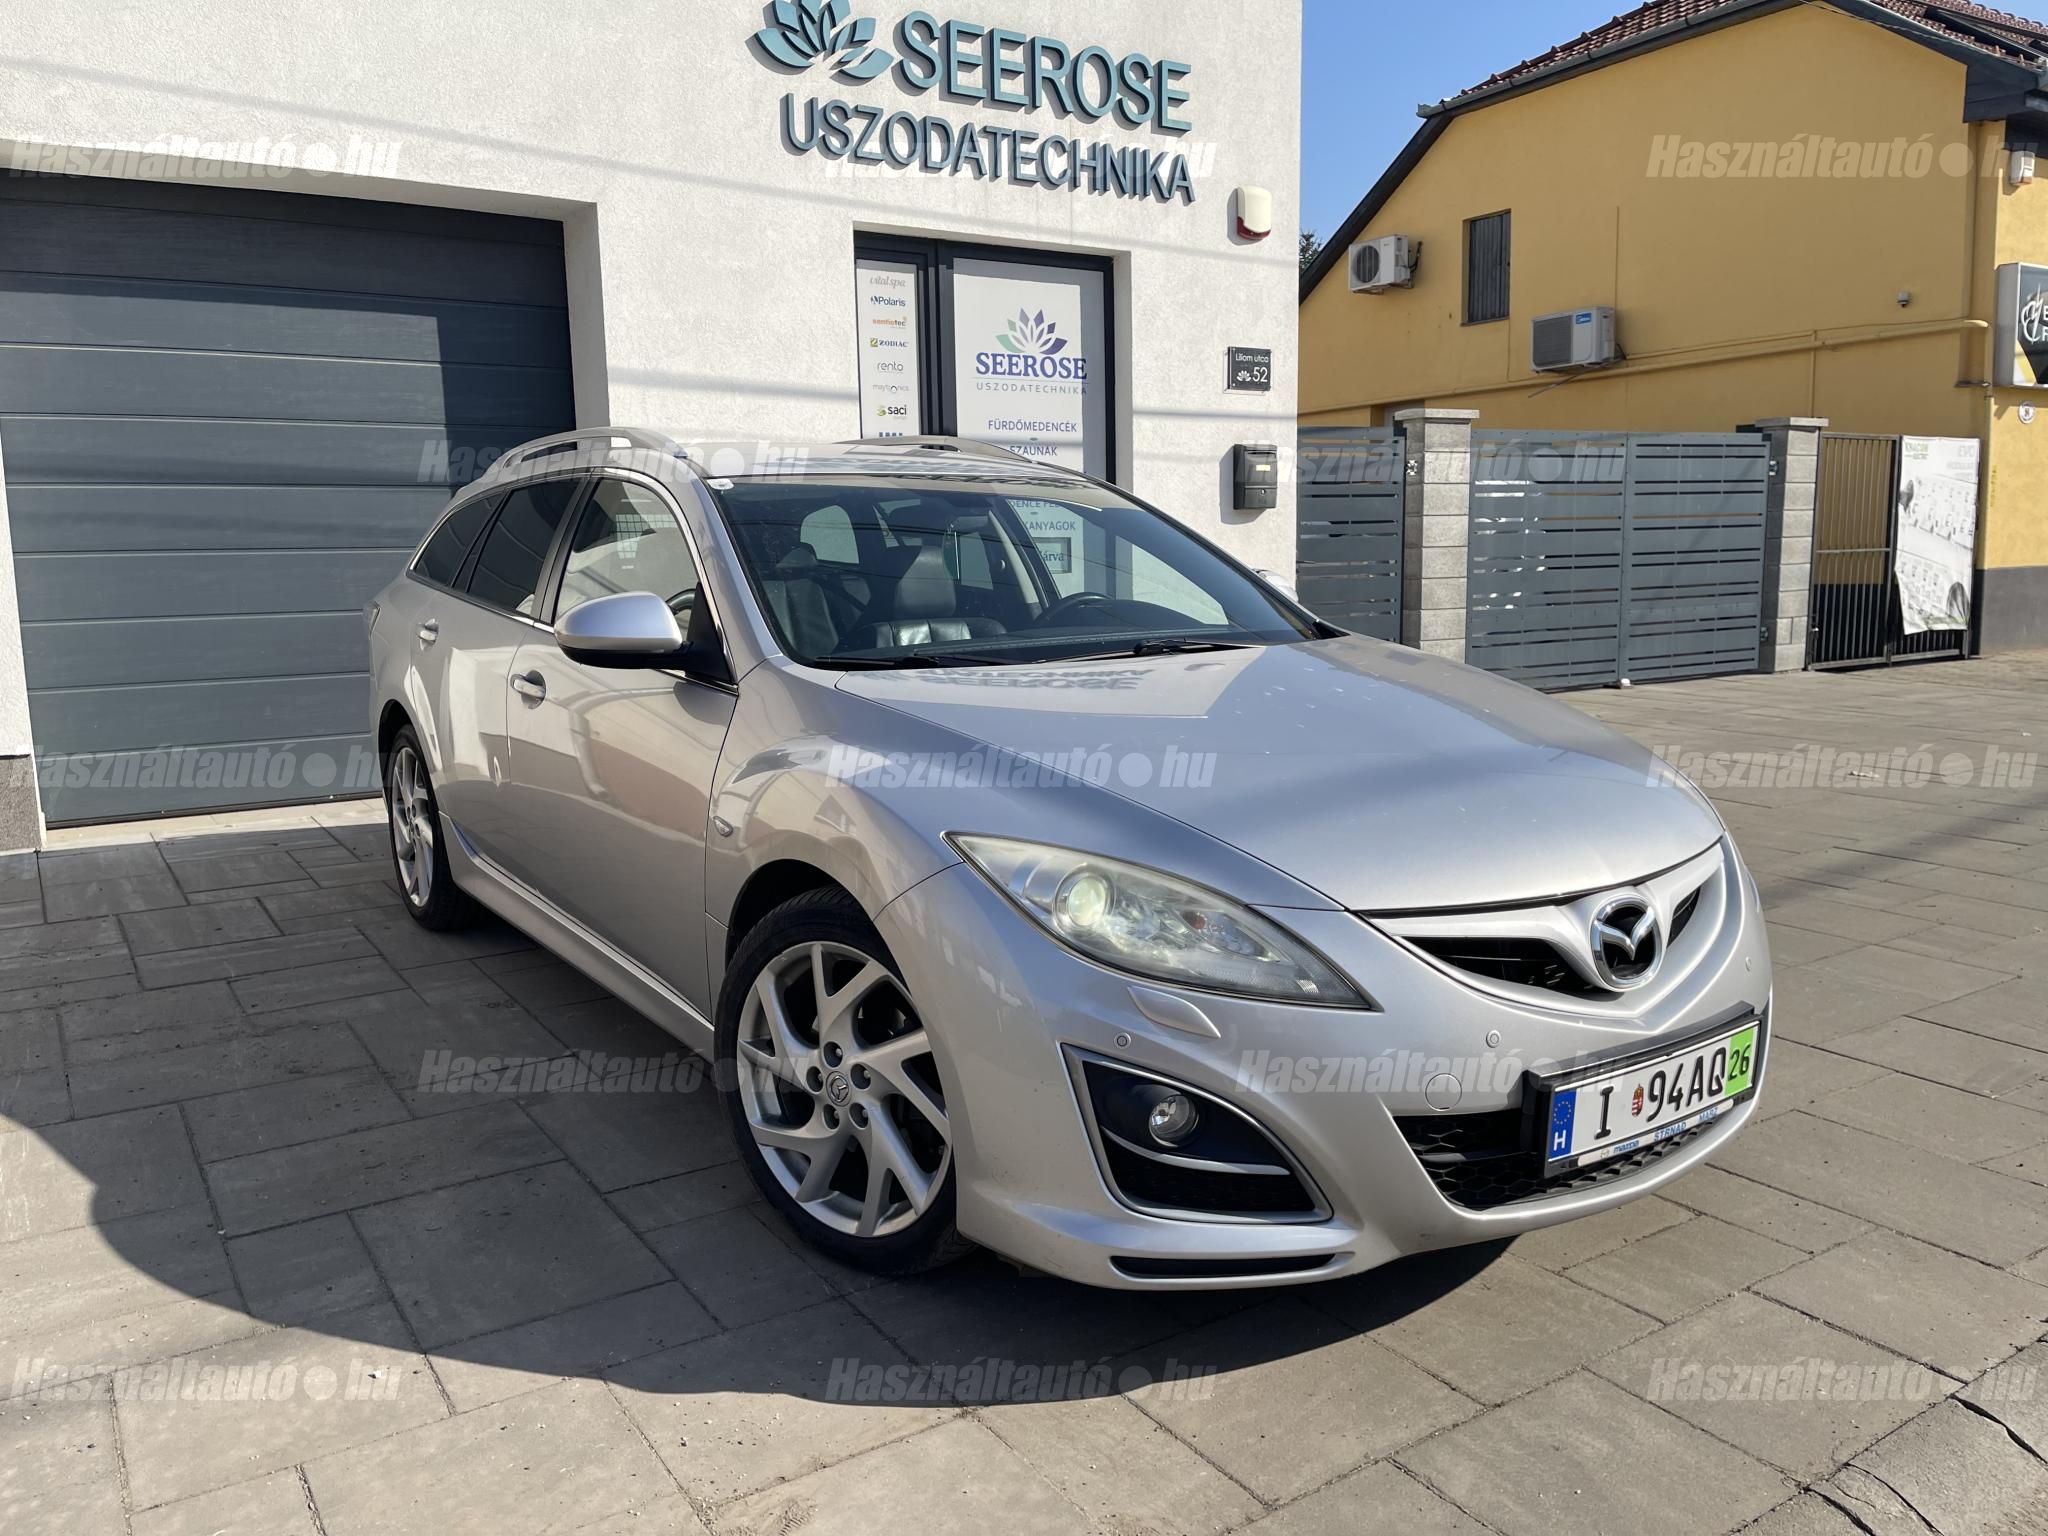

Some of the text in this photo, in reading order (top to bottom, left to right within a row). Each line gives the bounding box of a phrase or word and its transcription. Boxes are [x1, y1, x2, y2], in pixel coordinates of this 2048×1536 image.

[898, 10, 1193, 132] SEEROSE
[779, 92, 1196, 202] USZODATECHNIKA
[878, 296, 906, 307] Polaris
[879, 339, 908, 348] ZODIAC
[877, 361, 904, 372] rento
[975, 352, 1088, 380] SEEROSE
[1252, 366, 1268, 382] 52
[976, 382, 1088, 395] USZODATECHNIKA
[887, 404, 907, 415] saci
[1594, 1043, 1752, 1140] I 94AQ 26
[1553, 1129, 1567, 1151] H
[1653, 1121, 1688, 1142] STRNAD
